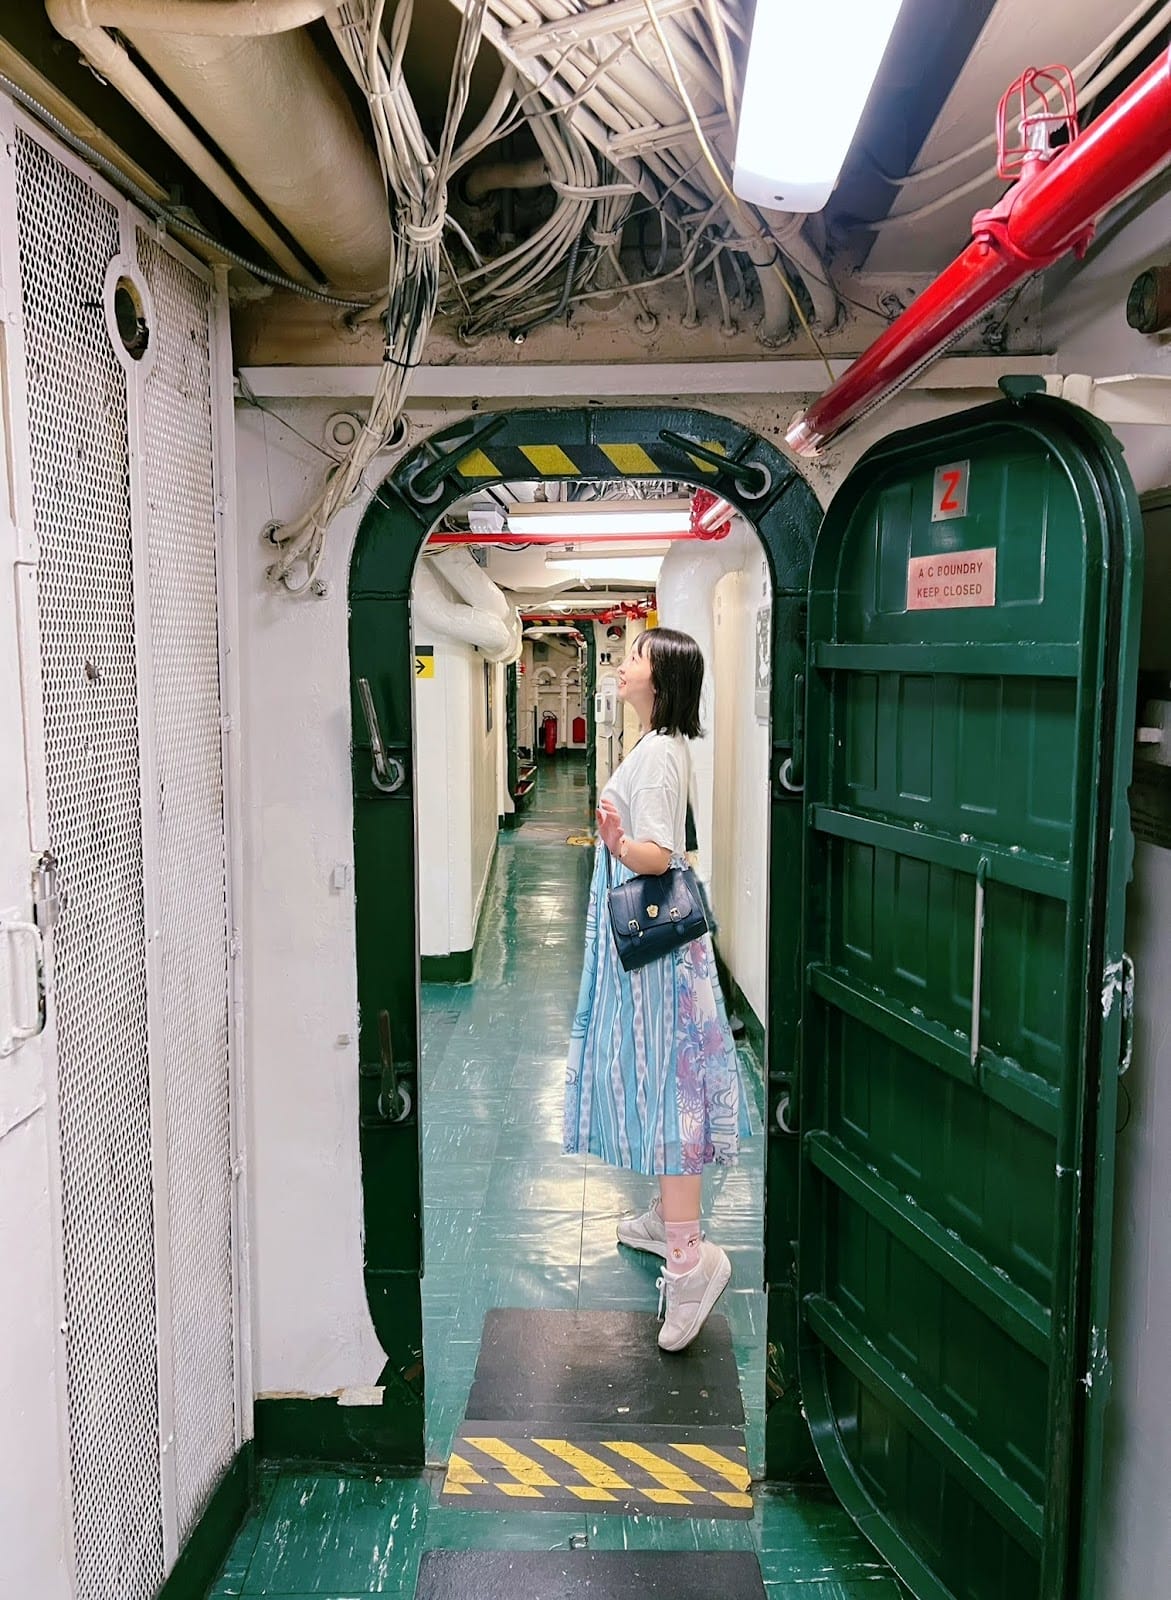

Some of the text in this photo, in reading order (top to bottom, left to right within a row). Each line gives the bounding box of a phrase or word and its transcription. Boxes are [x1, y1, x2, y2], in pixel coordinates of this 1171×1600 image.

[940, 470, 961, 512] Z
[918, 562, 983, 578] A C BOUNDRY
[917, 583, 982, 599] KEEP CLOSED
